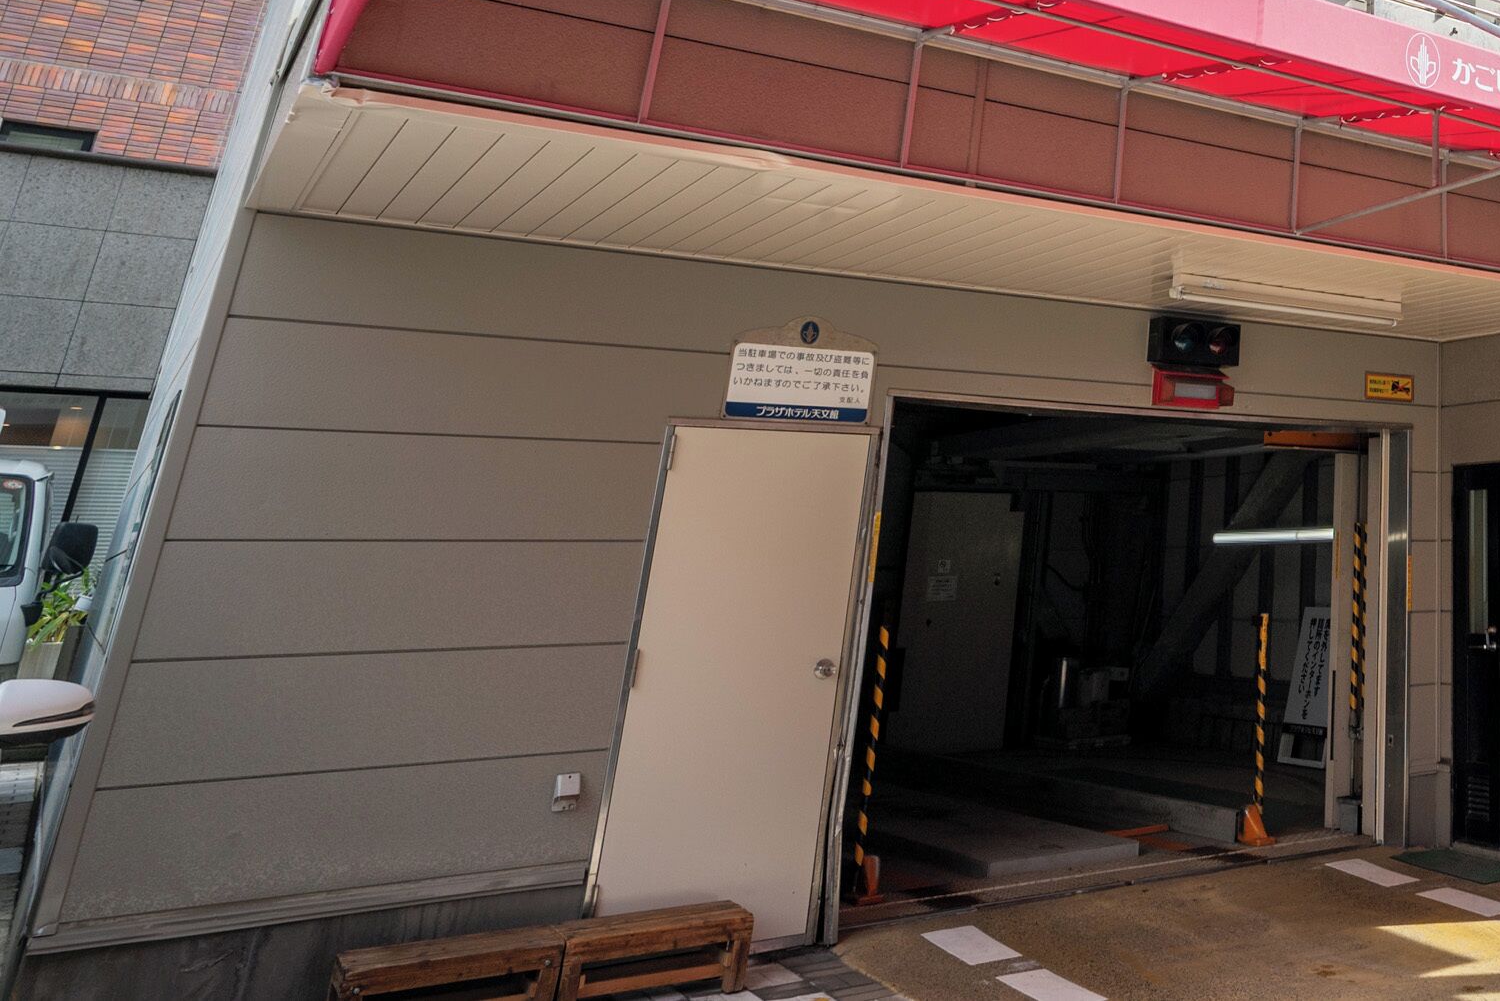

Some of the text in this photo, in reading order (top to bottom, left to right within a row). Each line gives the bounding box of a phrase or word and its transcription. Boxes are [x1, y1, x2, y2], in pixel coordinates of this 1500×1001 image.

[737, 347, 870, 365] 当駐車場での事故及び盗難等に
[756, 405, 839, 420] プラザホテル天文館
